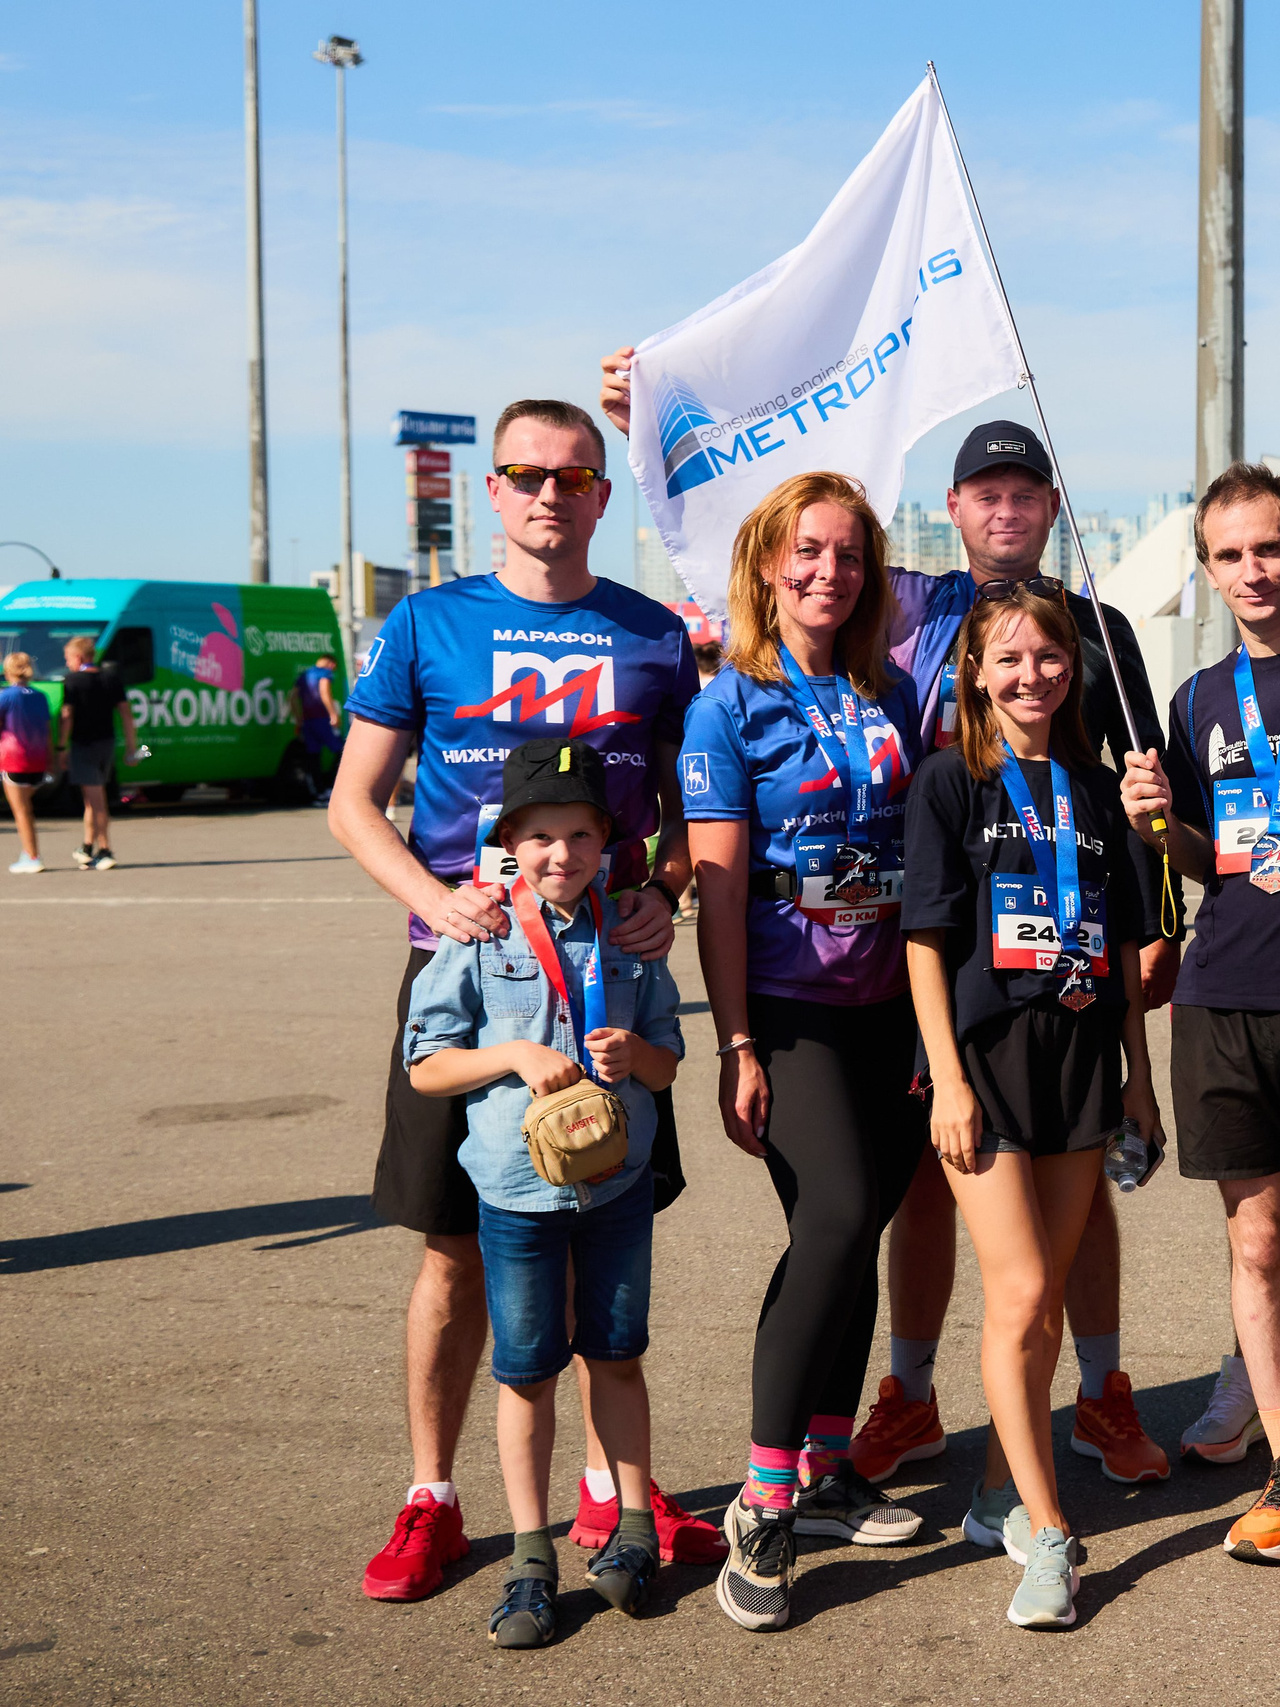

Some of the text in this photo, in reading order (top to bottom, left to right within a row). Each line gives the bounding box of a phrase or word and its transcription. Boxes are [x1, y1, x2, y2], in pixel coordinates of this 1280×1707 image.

[706, 247, 963, 476] METROPIS
[700, 344, 869, 443] consulting engineers
[493, 629, 613, 647] МАРАФОН
[128, 678, 300, 727] экомоби
[441, 748, 511, 764] НИЖН
[1219, 739, 1248, 756] consultin
[837, 911, 877, 923] 10 KM
[1017, 923, 1102, 950] 242 D
[1038, 956, 1053, 967] 10
